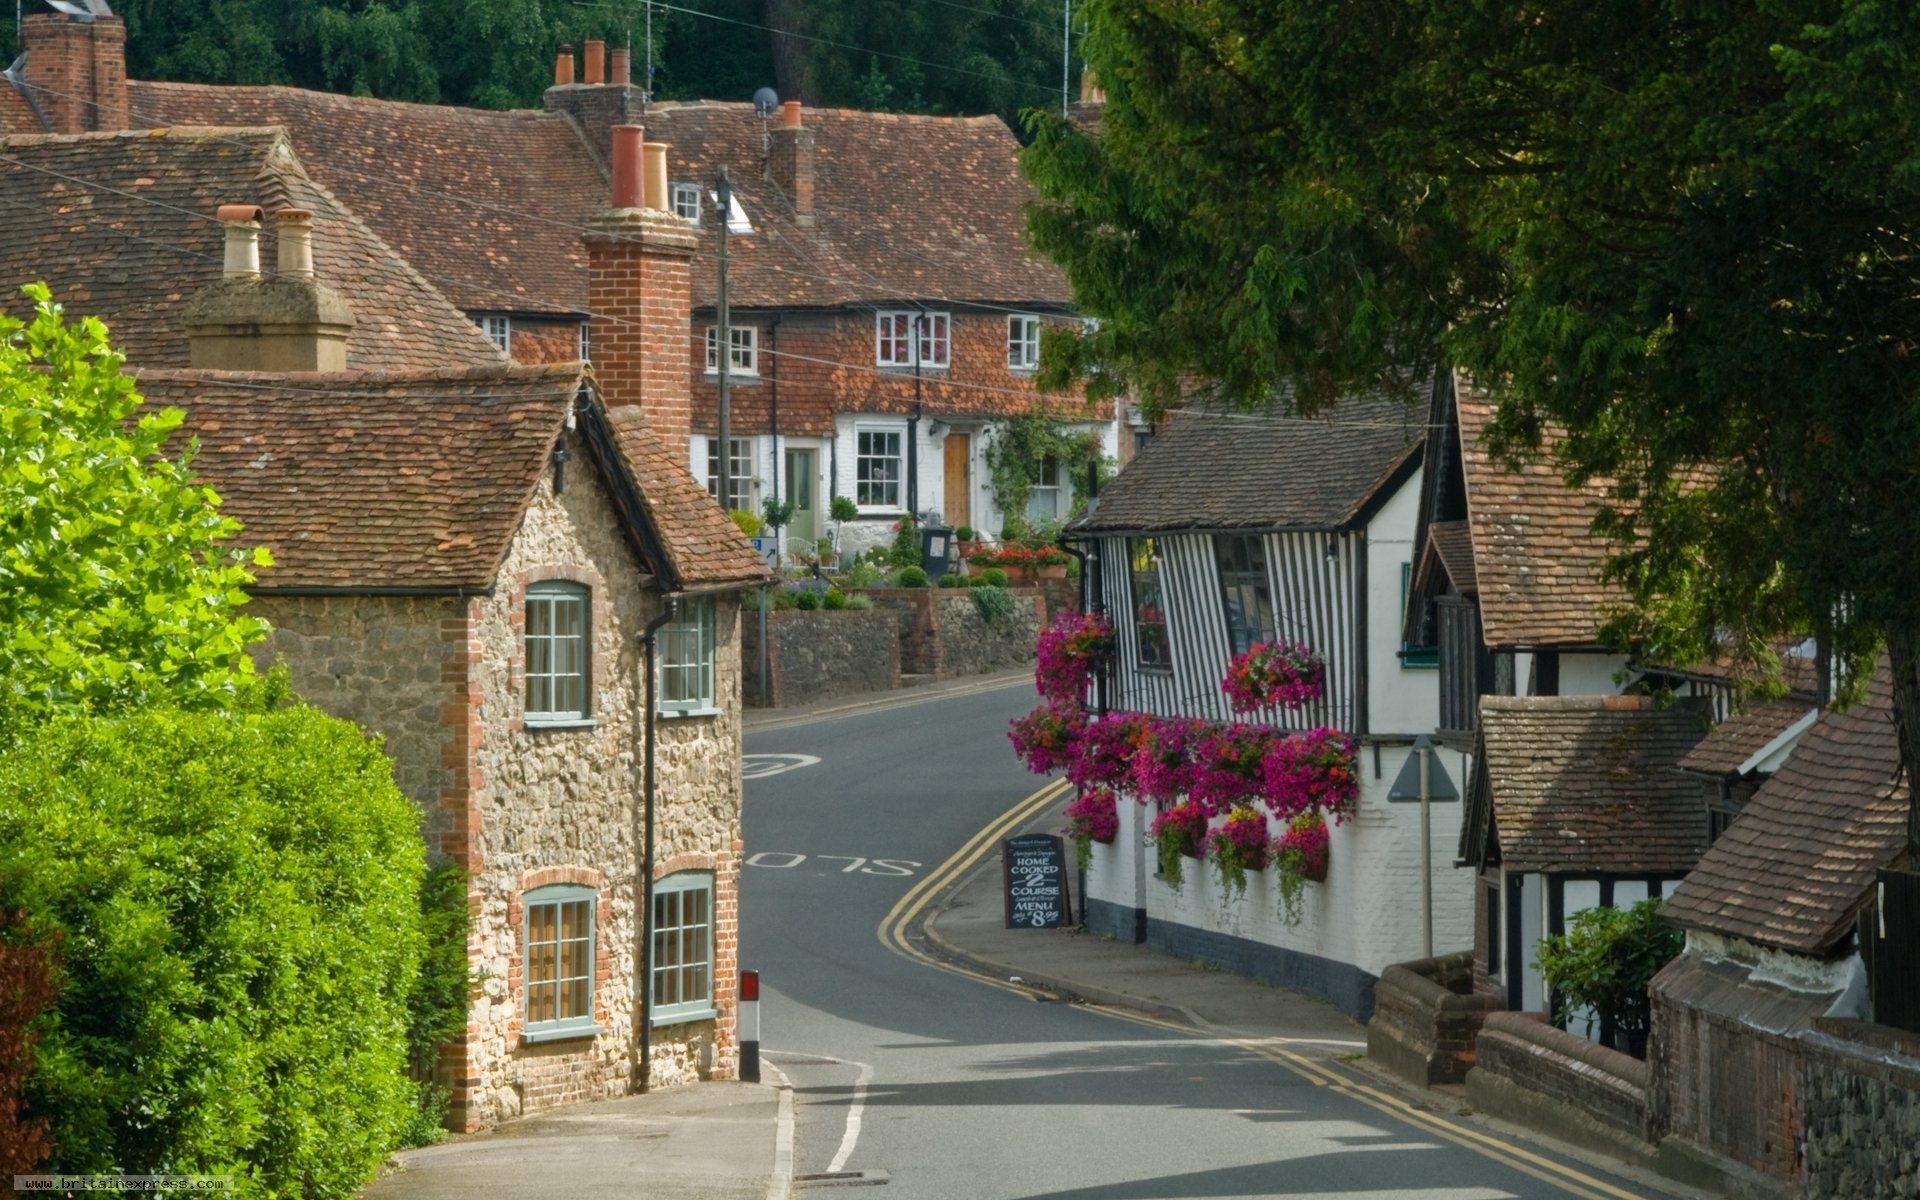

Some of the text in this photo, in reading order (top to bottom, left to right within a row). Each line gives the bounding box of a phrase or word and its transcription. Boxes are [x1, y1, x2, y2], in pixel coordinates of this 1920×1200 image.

[1017, 858, 1049, 866] HOME
[1011, 865, 1059, 874] COOKED
[1025, 873, 1044, 887] 2
[1011, 886, 1060, 896] COURSE
[1014, 902, 1053, 911] MENU
